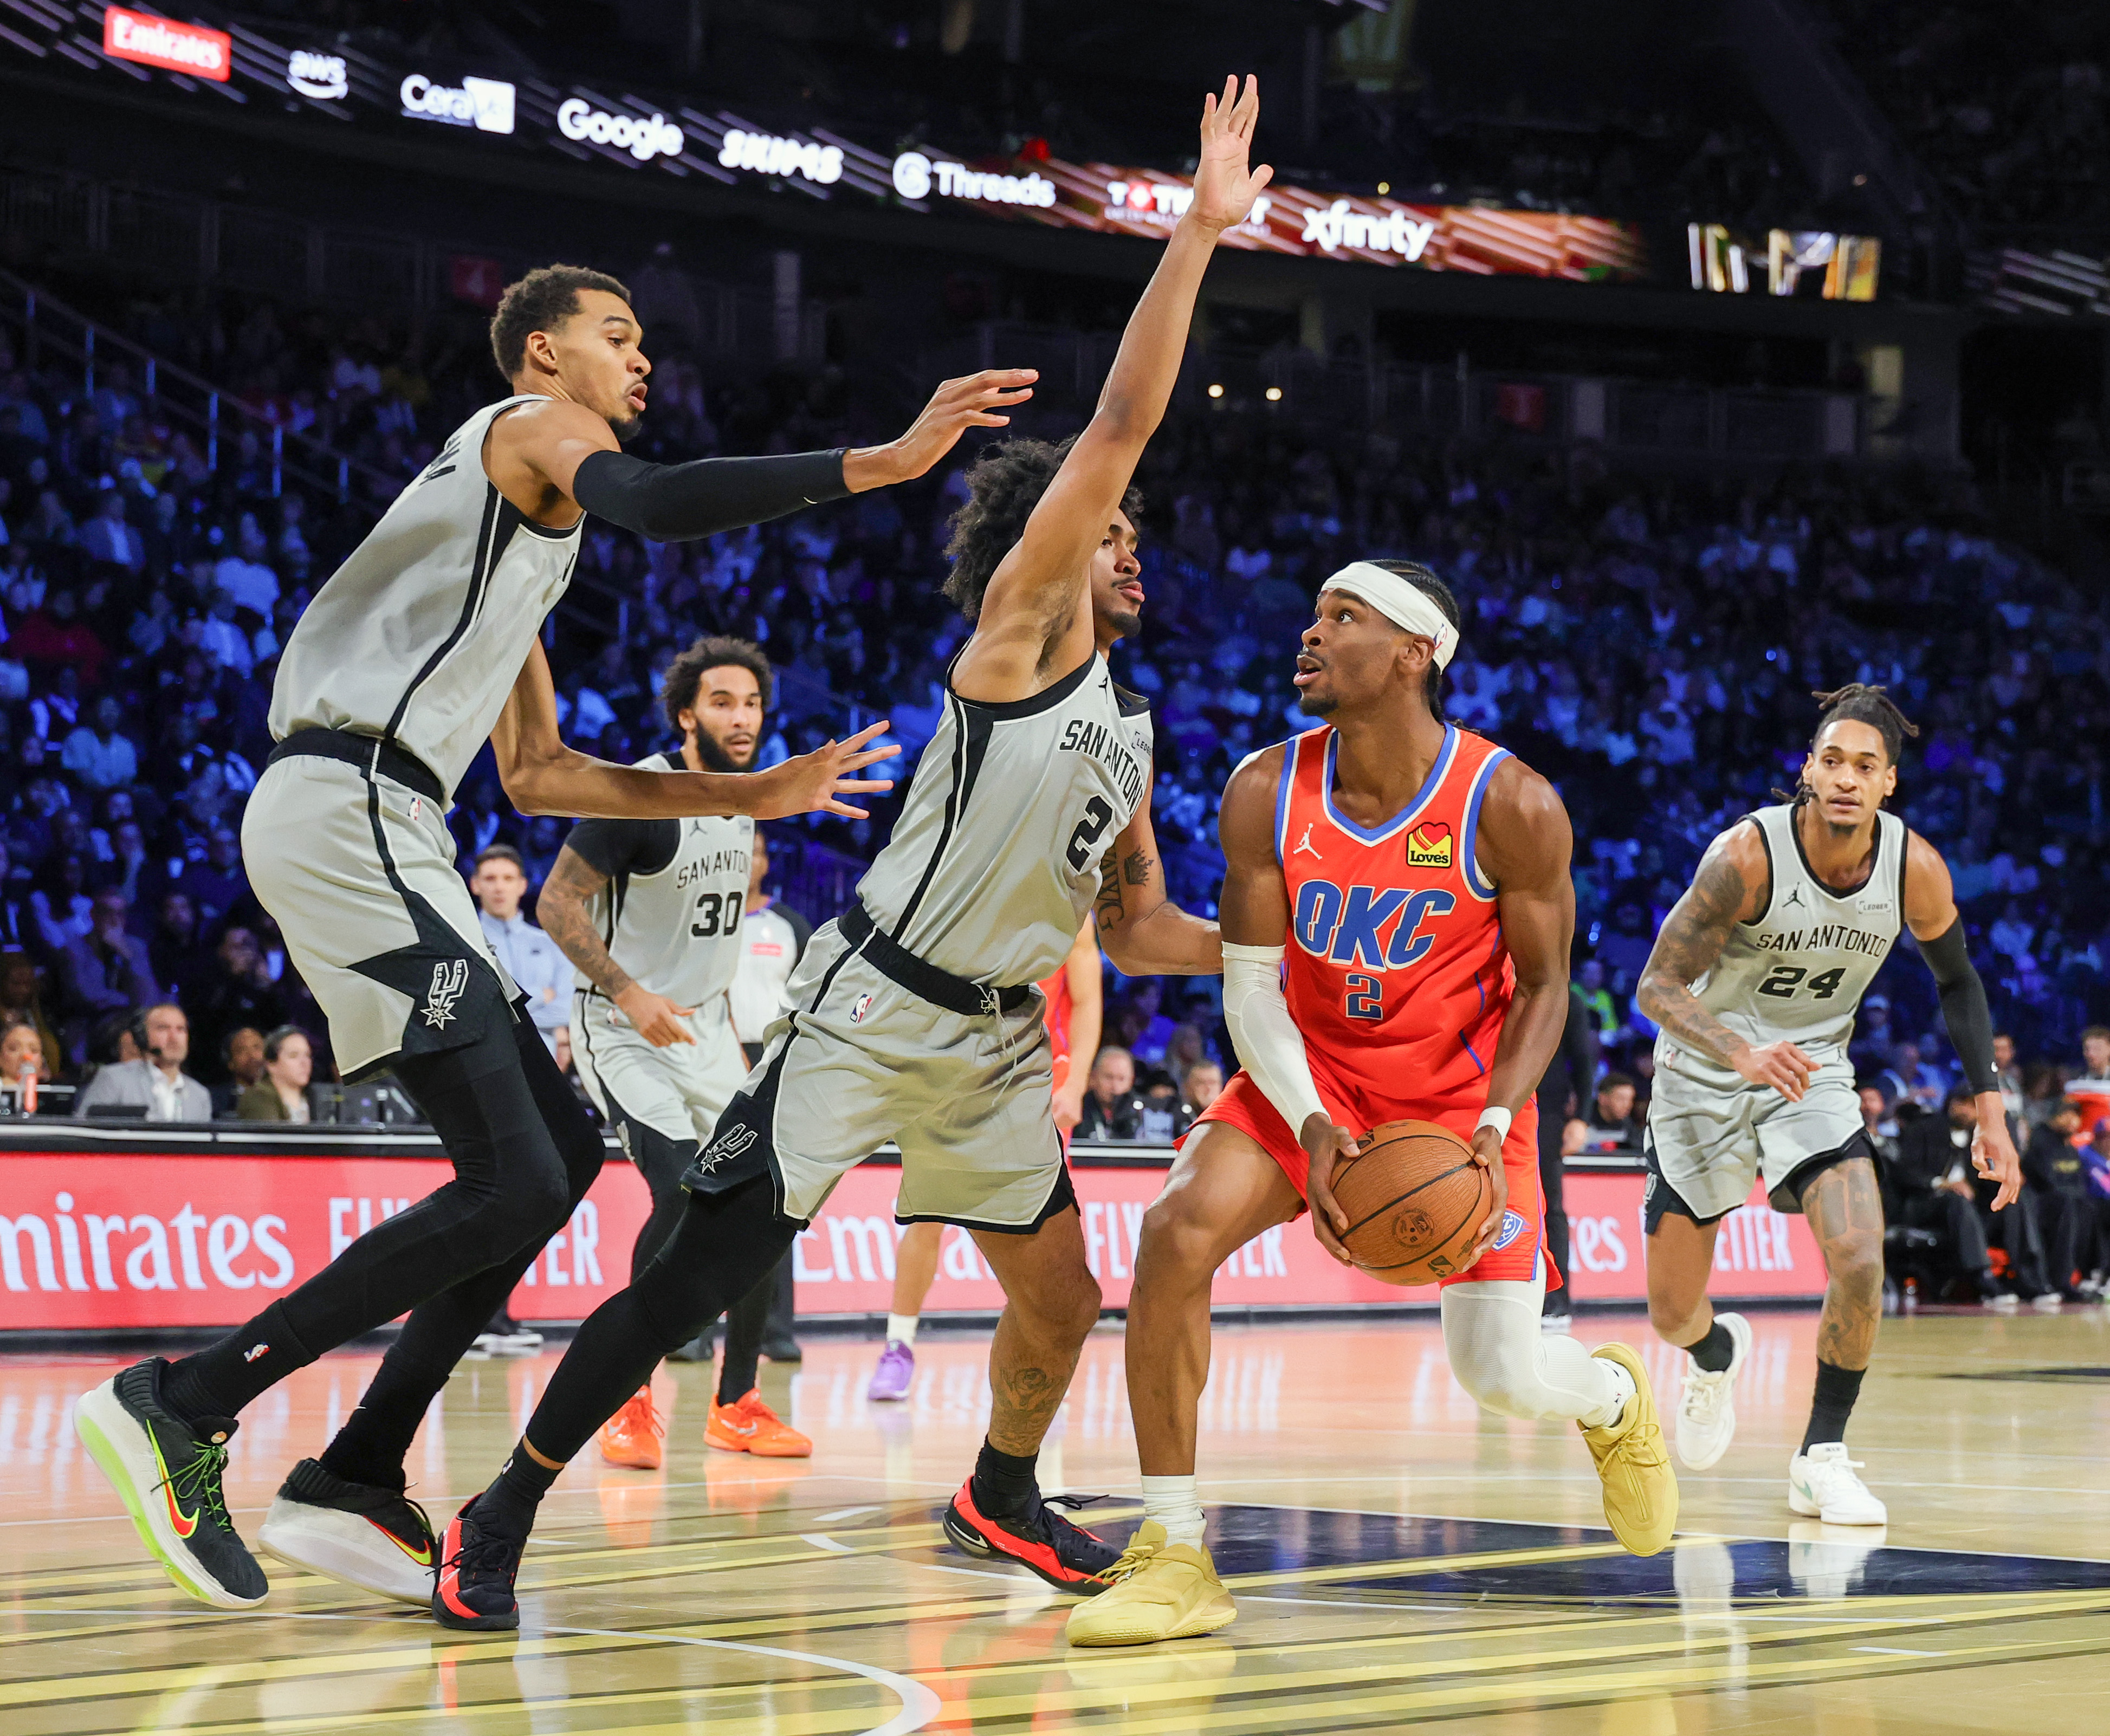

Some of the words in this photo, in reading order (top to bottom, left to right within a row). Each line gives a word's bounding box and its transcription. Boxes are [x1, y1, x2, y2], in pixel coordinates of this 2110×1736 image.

[113, 14, 222, 69] Emirates
[288, 50, 347, 84] aws
[557, 98, 684, 161] Google
[932, 161, 1056, 208] Threads
[1302, 198, 1434, 262] xfinity
[1059, 720, 1108, 759] SAN
[1066, 794, 1114, 874] 2
[677, 854, 709, 889] SAN
[691, 891, 743, 937] 30
[1293, 879, 1457, 973] OKC
[1756, 929, 1803, 952] SAN
[1805, 924, 1887, 958] ANTONIO
[1346, 973, 1383, 1020] 2
[1757, 967, 1847, 999] 24
[0, 1191, 295, 1291] mirates
[1713, 1204, 1794, 1271] ETTER
